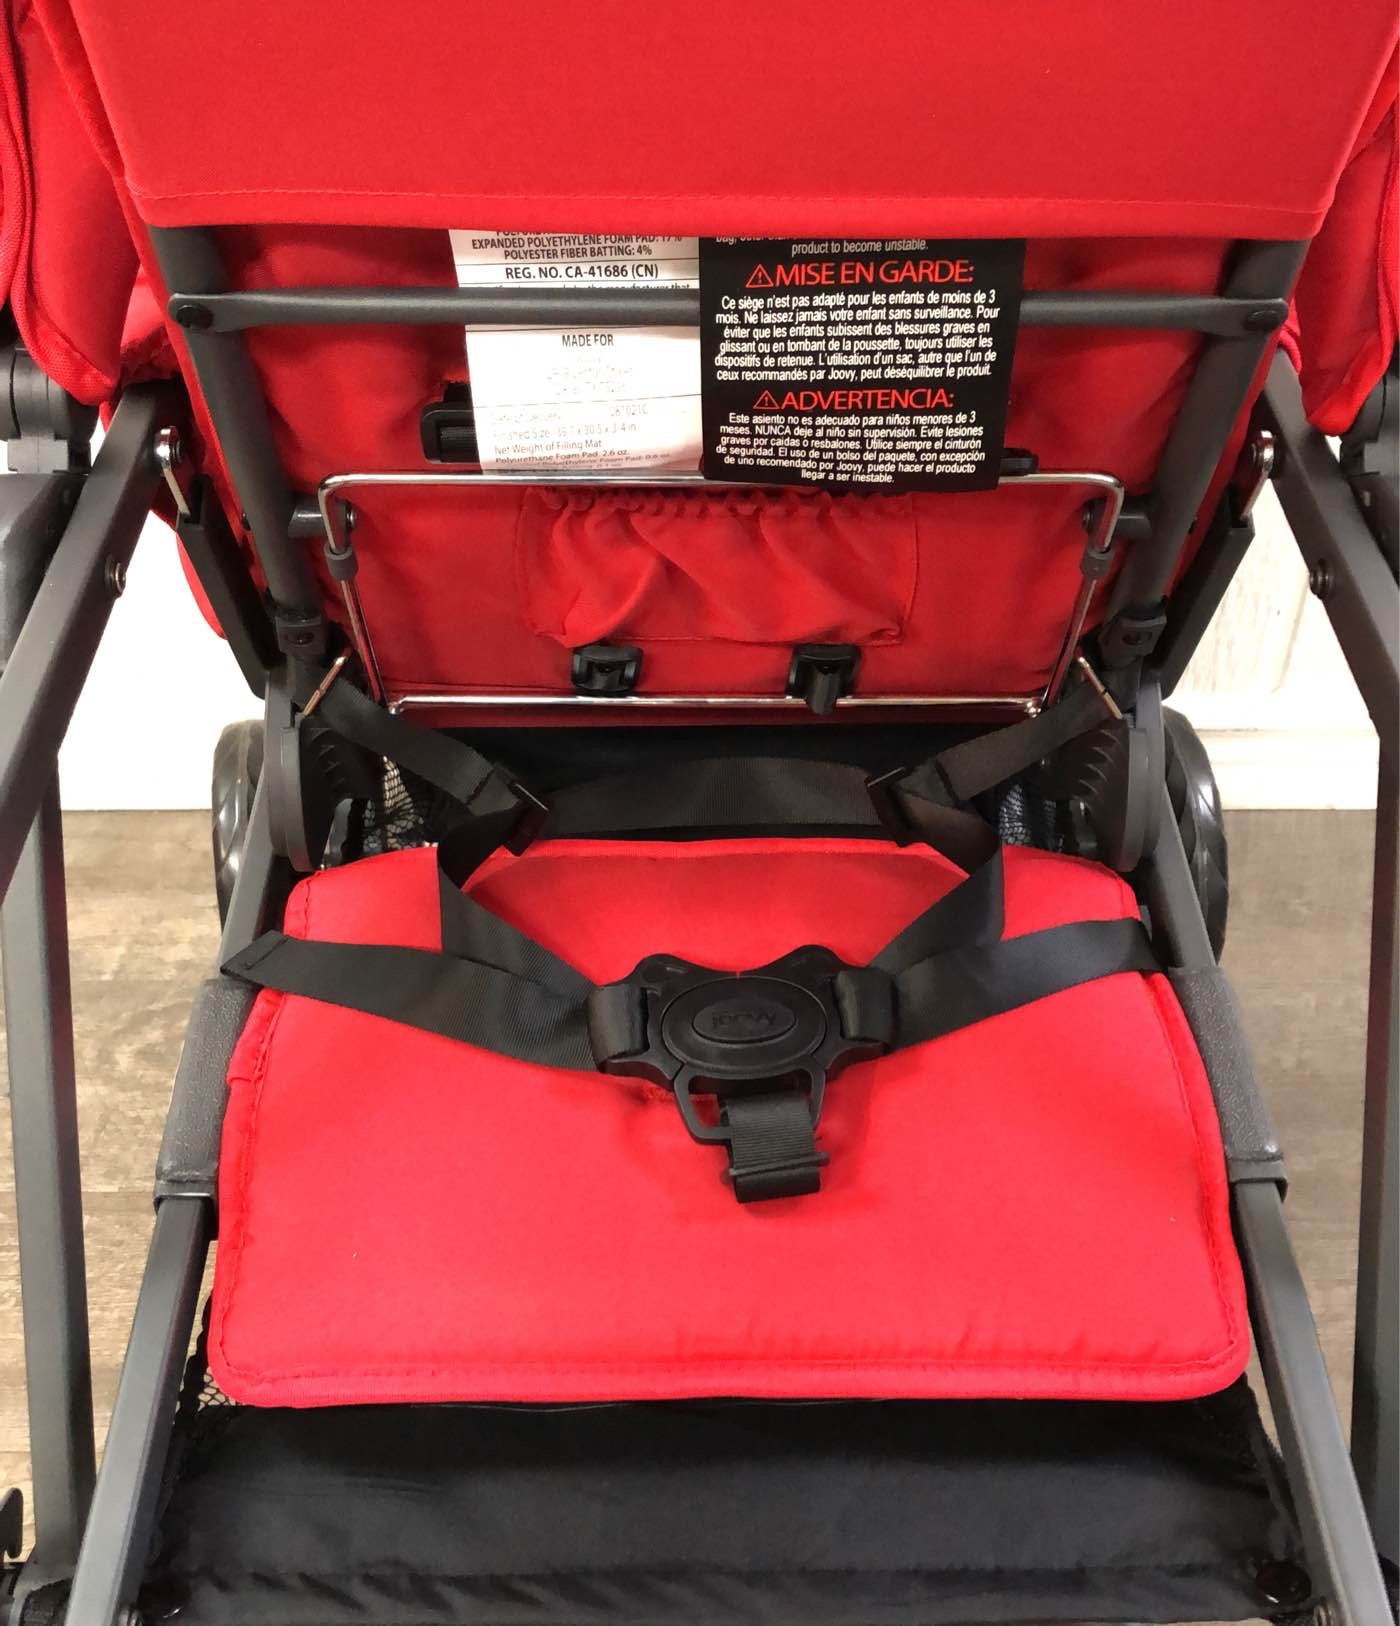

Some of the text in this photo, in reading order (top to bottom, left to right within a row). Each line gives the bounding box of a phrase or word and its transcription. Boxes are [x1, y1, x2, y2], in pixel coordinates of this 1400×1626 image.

[472, 238, 525, 250] EXPANDED
[528, 235, 602, 248] POLYETHYLENE
[792, 239, 928, 257] product to become unstable.
[504, 245, 652, 260] POLYESTER FIBER BATTING: 4%
[505, 263, 659, 279] REG. NO. CA-41686 (CN)
[775, 260, 975, 287] MISE EN GARDE:
[721, 296, 736, 309] Ce
[738, 296, 764, 312] siège
[792, 297, 810, 312] pas
[812, 292, 845, 311] adapté
[848, 293, 870, 309] pour
[872, 291, 887, 305] les
[889, 291, 924, 305] enfants
[927, 290, 939, 304] de
[942, 290, 971, 304] moins
[974, 290, 987, 304] de
[988, 289, 996, 304] 3
[716, 305, 1001, 324] mois. Ne laissez jamais votre enfant sans surveillance. Pour
[561, 333, 615, 347] MADE FOR
[724, 321, 990, 341] éviter que les enfants subissent des blessures graves en
[720, 335, 993, 356] glissant ou en tombant de la poussette, toujours utiliser les
[714, 354, 761, 369] dispositifs
[763, 354, 775, 367] de
[777, 355, 816, 367] retenue.
[896, 354, 915, 365] sac,
[918, 351, 943, 364] autre
[945, 352, 963, 365] que
[984, 350, 997, 362] de
[717, 370, 739, 381] ceux
[810, 369, 825, 382] par
[828, 368, 858, 382] Joovy,
[861, 367, 882, 382] peut
[884, 365, 944, 380] déséquilibrer
[946, 364, 955, 377] le
[957, 364, 992, 379] produit.
[781, 388, 954, 410] ADVERTENCIA:
[729, 410, 976, 427] Este asiento no es adecuado para niños menores de 3
[720, 425, 984, 442] meses. NUNCA deje al niño sin supervisión. Evite lesiones
[585, 439, 602, 449] Mat
[721, 436, 751, 446] graves
[753, 438, 768, 448] por
[802, 439, 809, 447] o
[811, 438, 863, 450] resbalones.
[865, 439, 893, 450] Utilice
[895, 439, 932, 452] siempre
[934, 439, 943, 450] el
[944, 438, 982, 450] cinturón
[716, 444, 986, 463] de seguridad. El uso de un bolso del paquete, con excepción
[724, 455, 976, 475] de uno recomendado por Joovy, puede hacer el producto
[801, 470, 894, 483] llegar a ser inestable.
